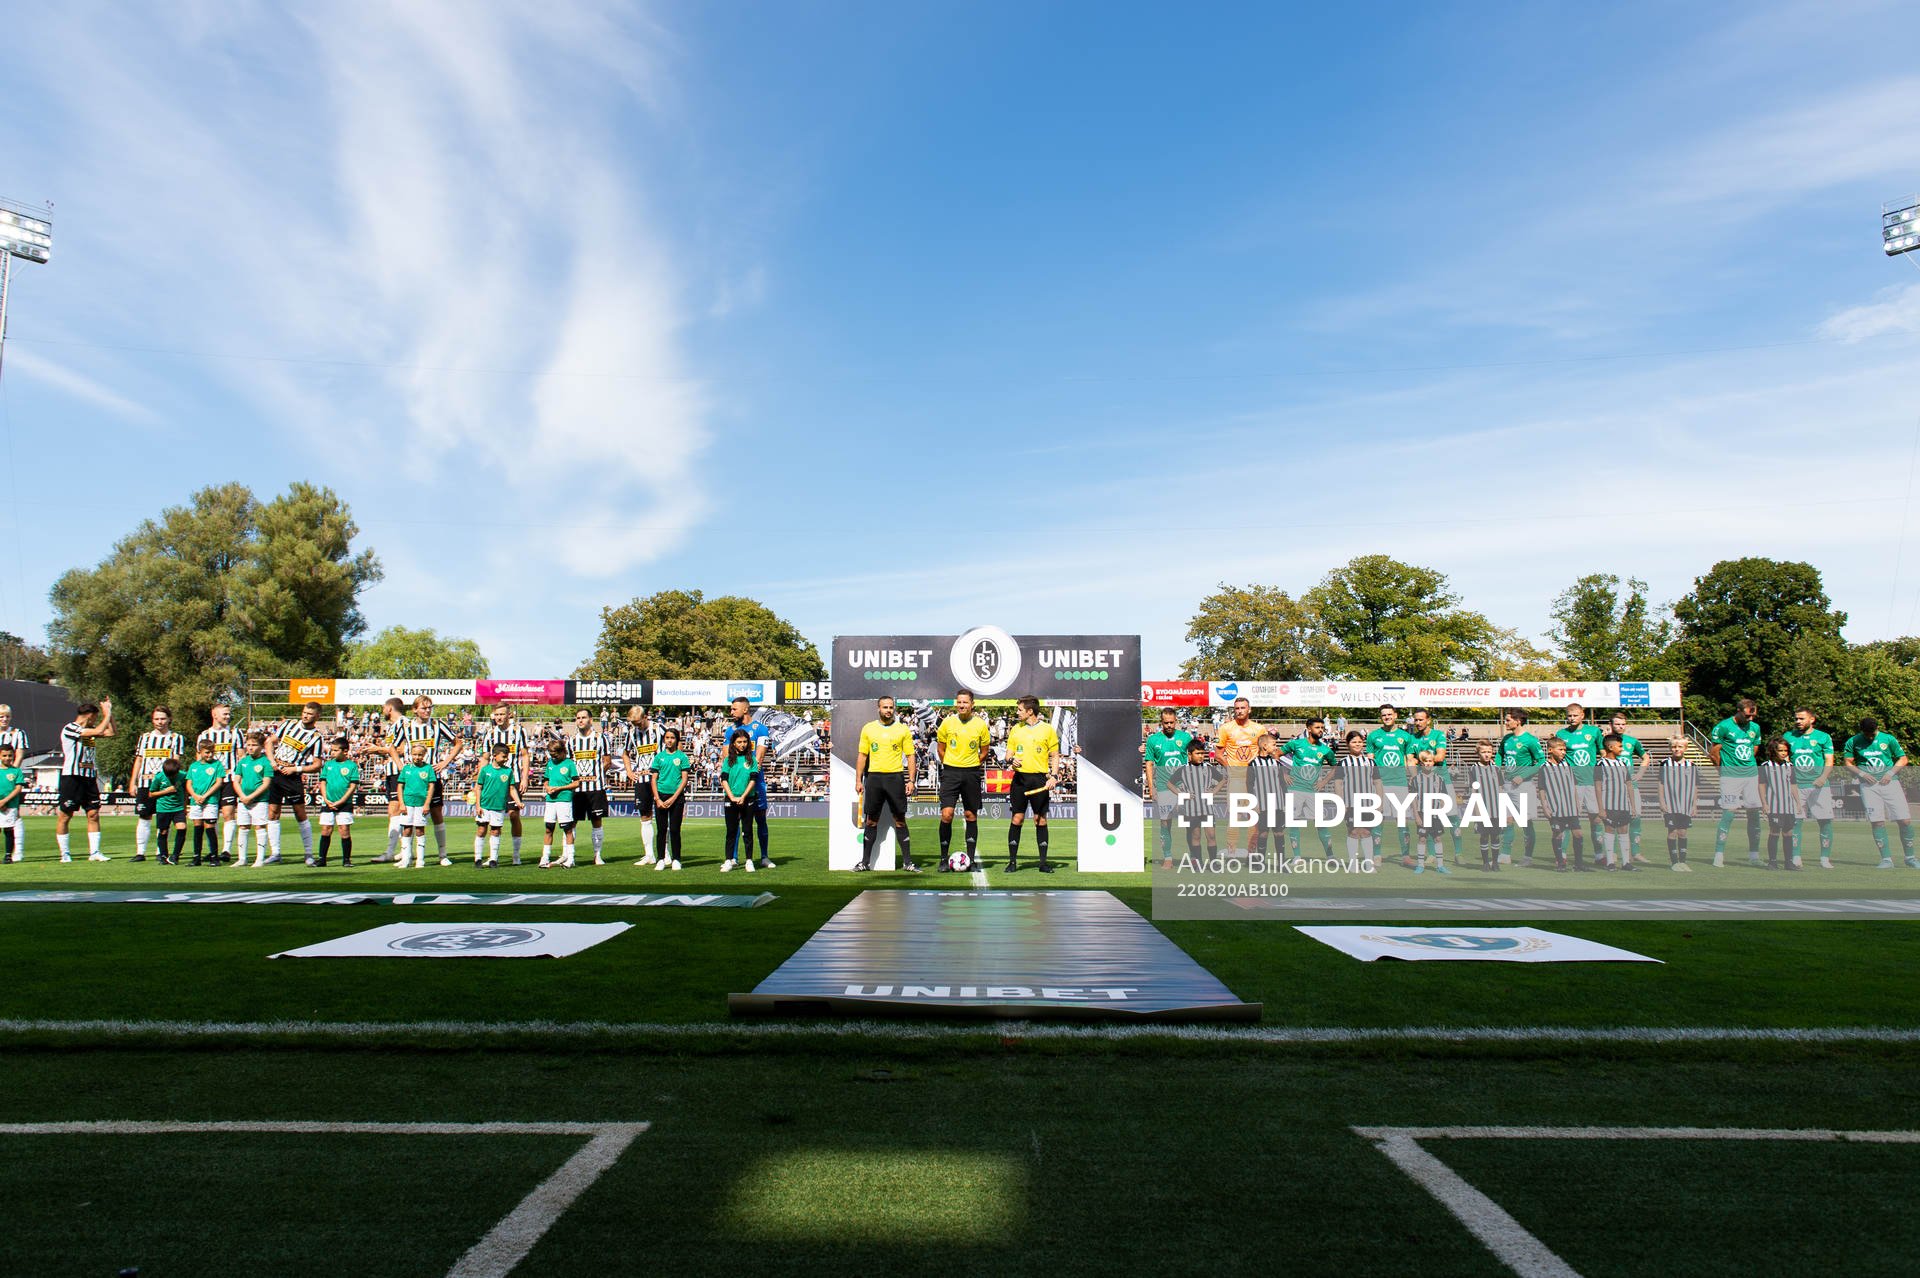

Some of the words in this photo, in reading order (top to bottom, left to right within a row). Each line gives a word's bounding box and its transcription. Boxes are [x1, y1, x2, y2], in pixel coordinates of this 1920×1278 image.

[848, 649, 933, 668] UNIBET
[1038, 649, 1124, 668] UNIBET
[297, 684, 329, 695] renta
[389, 688, 472, 696] LOKALTIDNINGEN
[575, 681, 642, 700] infosign
[656, 688, 711, 697] Handelsbanken
[729, 688, 762, 698] Haldex
[1419, 687, 1491, 696] RINGSERVICE
[1499, 686, 1538, 697] DÄCK
[1549, 687, 1588, 697] CITY
[1340, 692, 1406, 702] WILENSKY
[608, 804, 629, 816] NU
[1099, 803, 1122, 832] U
[844, 985, 1138, 1000] UNIBET
